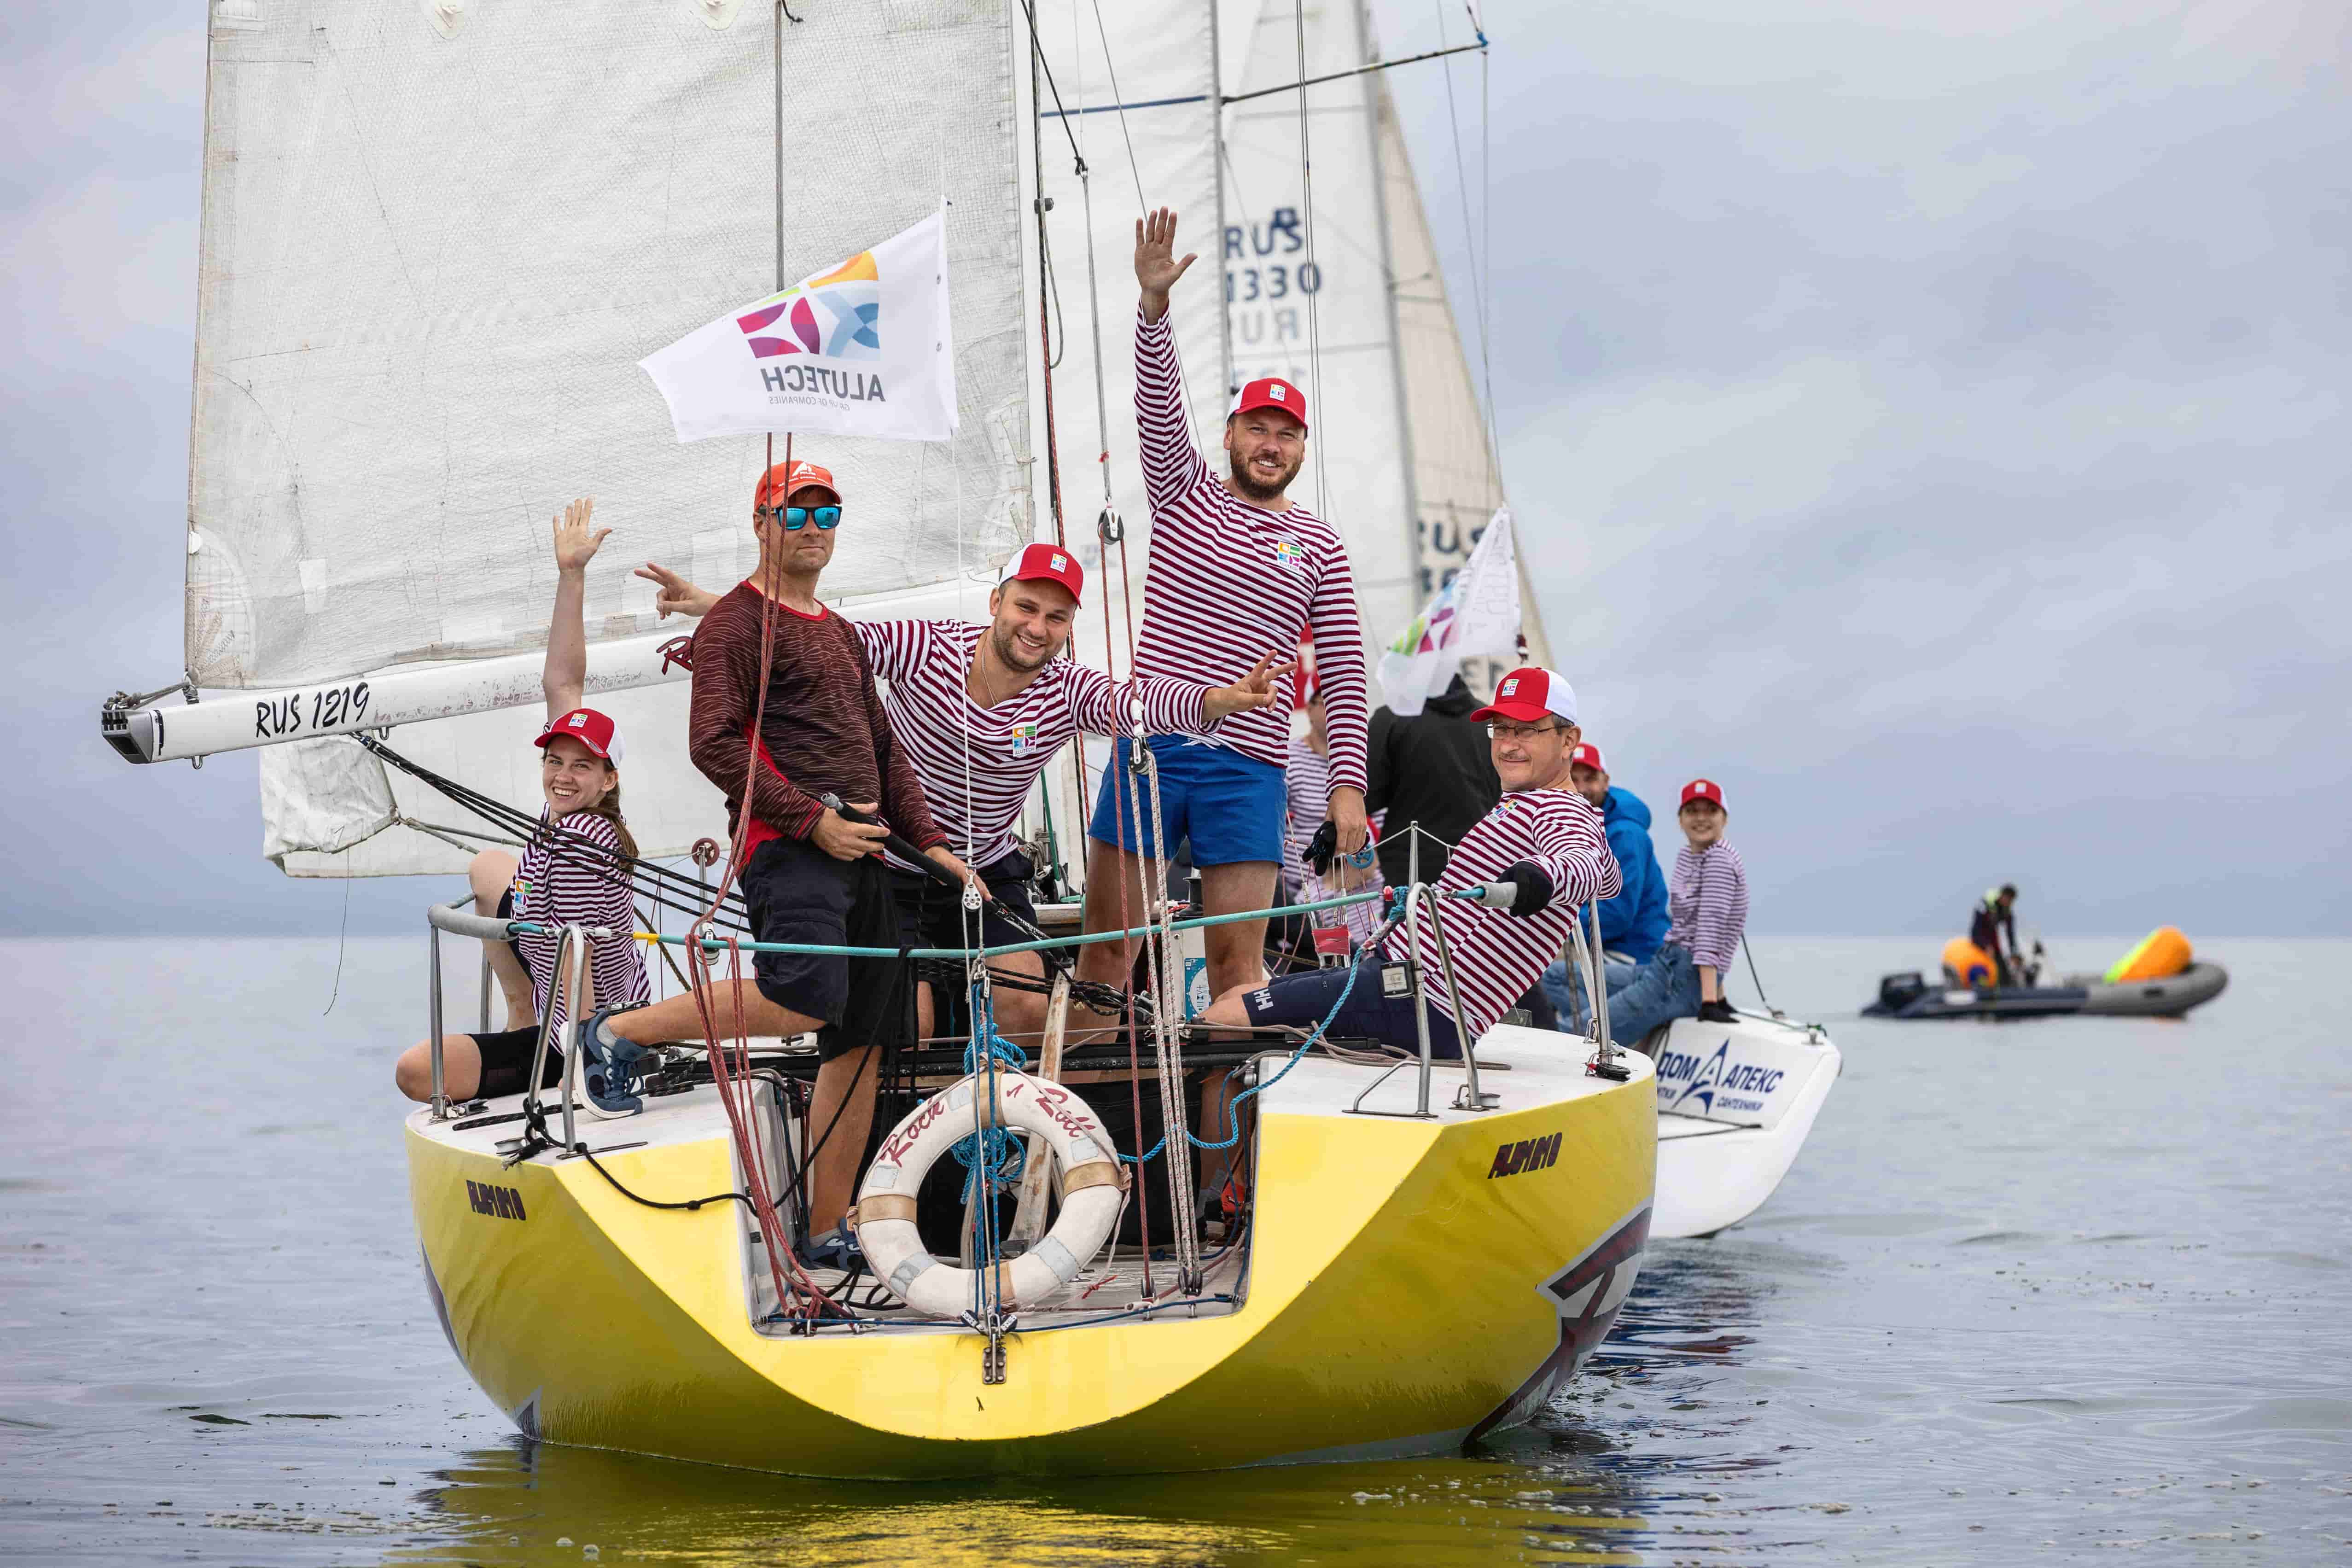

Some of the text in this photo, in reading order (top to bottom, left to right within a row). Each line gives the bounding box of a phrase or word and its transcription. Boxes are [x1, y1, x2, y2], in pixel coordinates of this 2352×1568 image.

[1224, 220, 1304, 259] RUS
[1226, 262, 1321, 302] 1330
[256, 682, 370, 738] RUS 1219
[1721, 1063, 1784, 1093] АПЕКС
[880, 1097, 944, 1168] Rock
[1035, 1088, 1096, 1137] Roll
